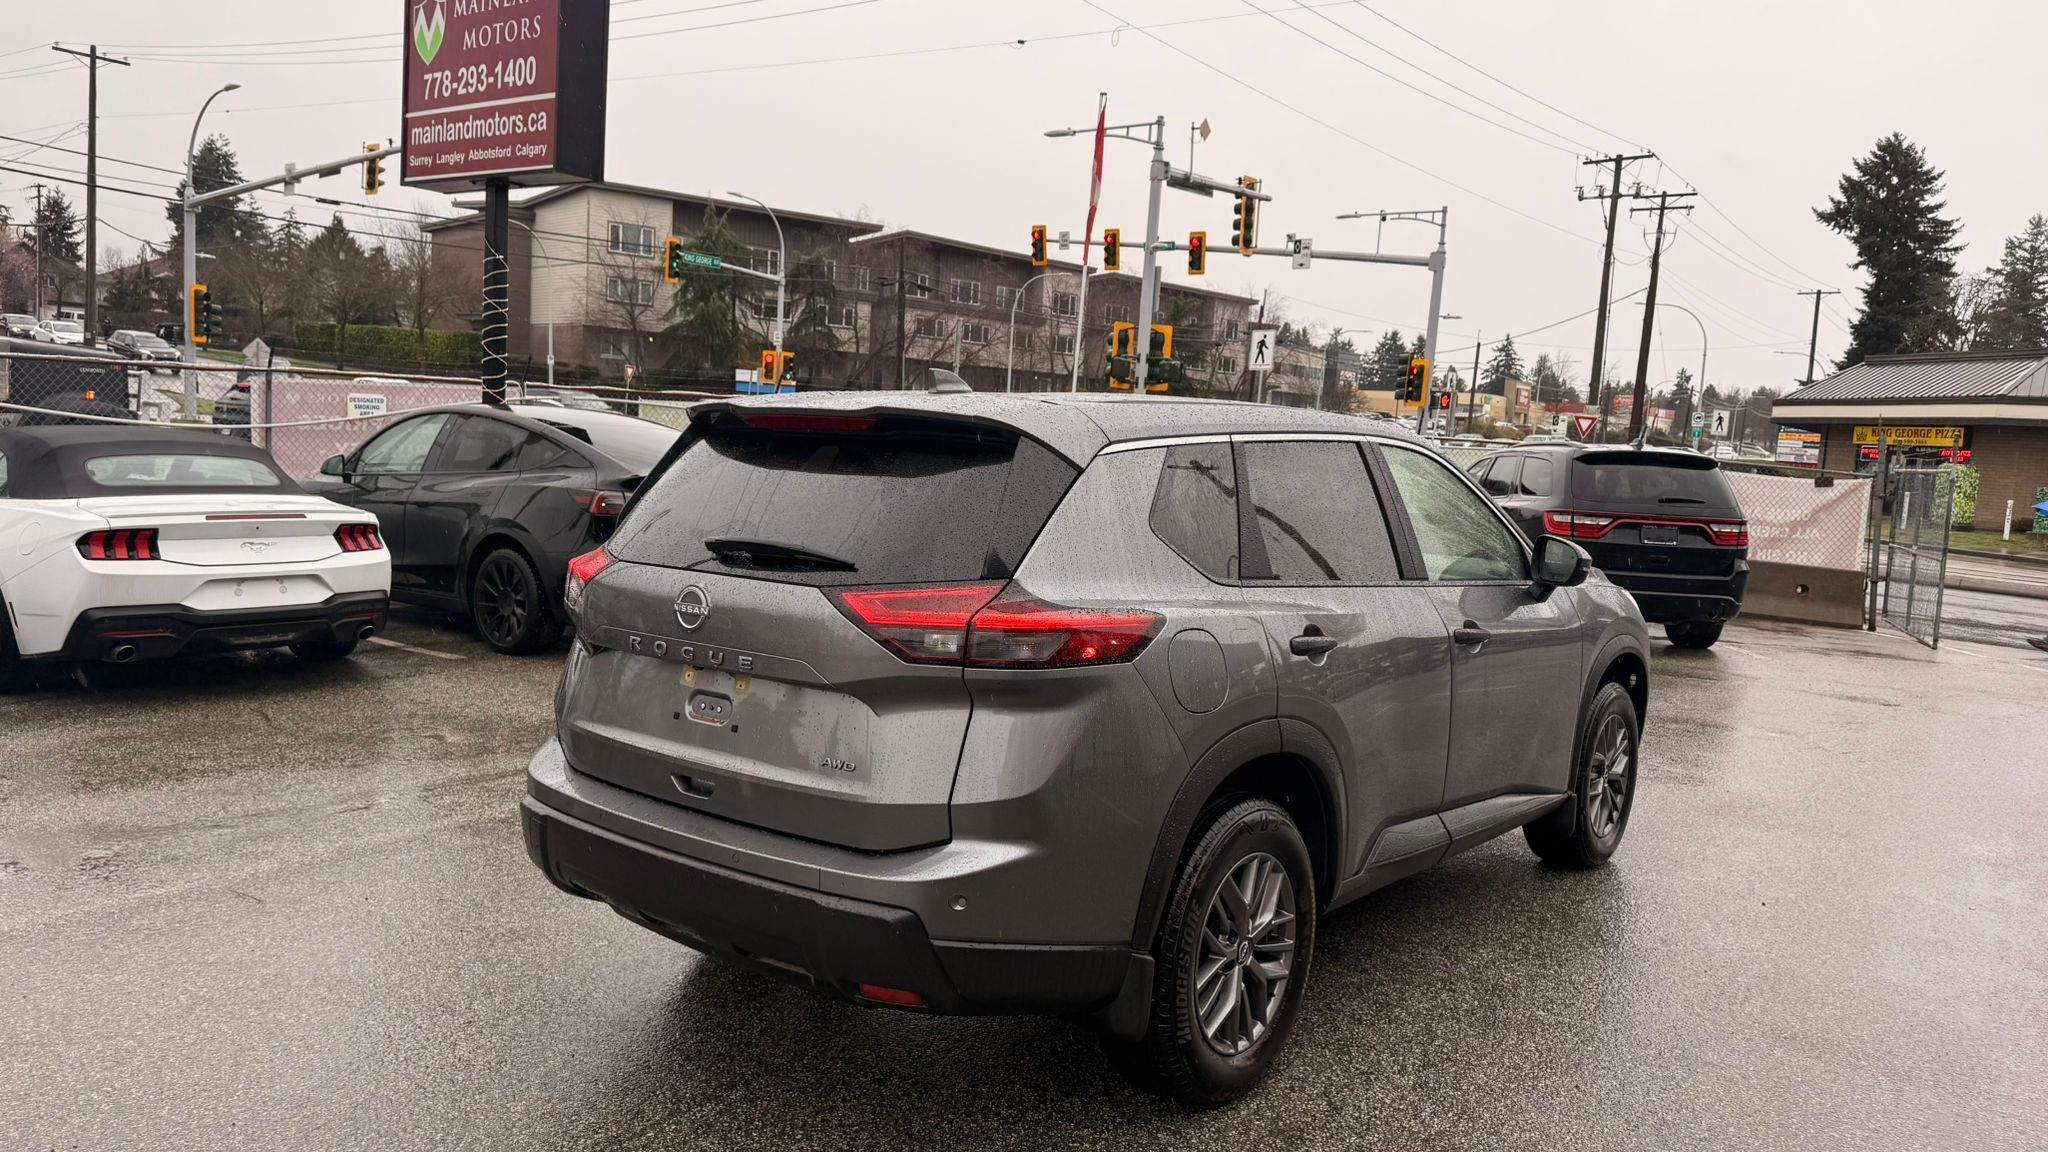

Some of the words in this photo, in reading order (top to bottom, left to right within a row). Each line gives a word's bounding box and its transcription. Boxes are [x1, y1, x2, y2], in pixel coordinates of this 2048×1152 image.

[463, 15, 542, 51] MOTORS
[423, 55, 538, 101] 778-293-1400
[411, 111, 548, 146] mainlandmotors.ca
[409, 155, 433, 167] Surrey
[436, 151, 465, 165] Langley
[468, 145, 512, 161] Abbotsford
[515, 143, 548, 159] Calgary
[349, 396, 385, 404] DESIGNATED
[1895, 428, 1932, 439] GEORGE
[674, 603, 710, 616] NISSAN
[629, 635, 753, 670] ROGUE
[821, 757, 856, 773] AWD
